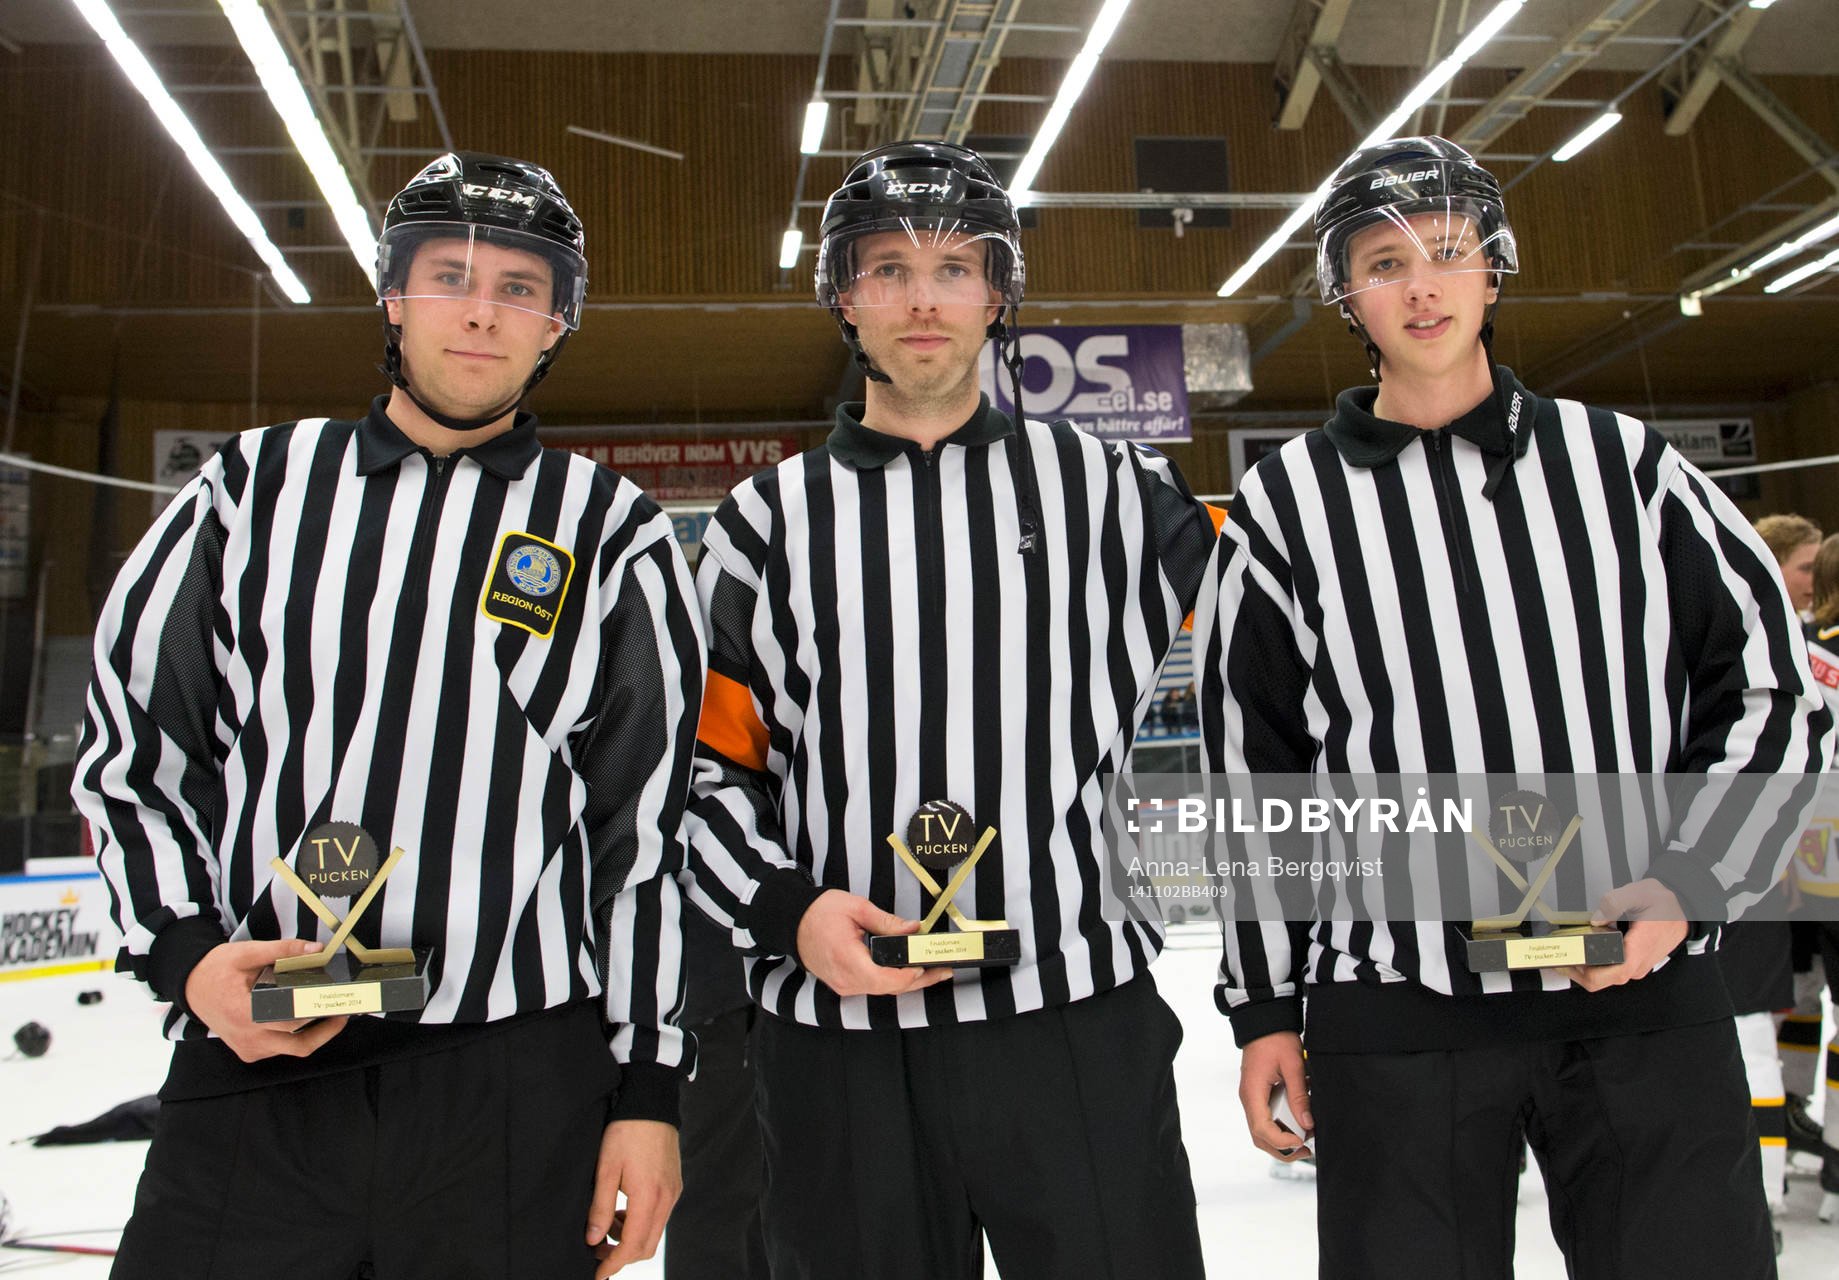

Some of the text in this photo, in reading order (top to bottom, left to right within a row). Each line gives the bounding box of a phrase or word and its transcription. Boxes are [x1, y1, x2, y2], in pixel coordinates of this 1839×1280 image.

[886, 183, 952, 198] CCM
[1370, 170, 1439, 190] BAUER
[462, 184, 535, 208] CCM
[613, 444, 678, 465] BEHÖVER
[685, 444, 725, 462] INOM
[729, 440, 783, 464] VVS
[492, 591, 553, 621] REGION ÖST
[919, 813, 961, 842] TV
[1499, 804, 1543, 834] TV
[311, 835, 360, 869] TV
[916, 843, 968, 855] PUCKEN
[1499, 835, 1553, 848] PUCKEN
[309, 869, 369, 884] PUCKEN
[2, 906, 80, 940] HOCKEY
